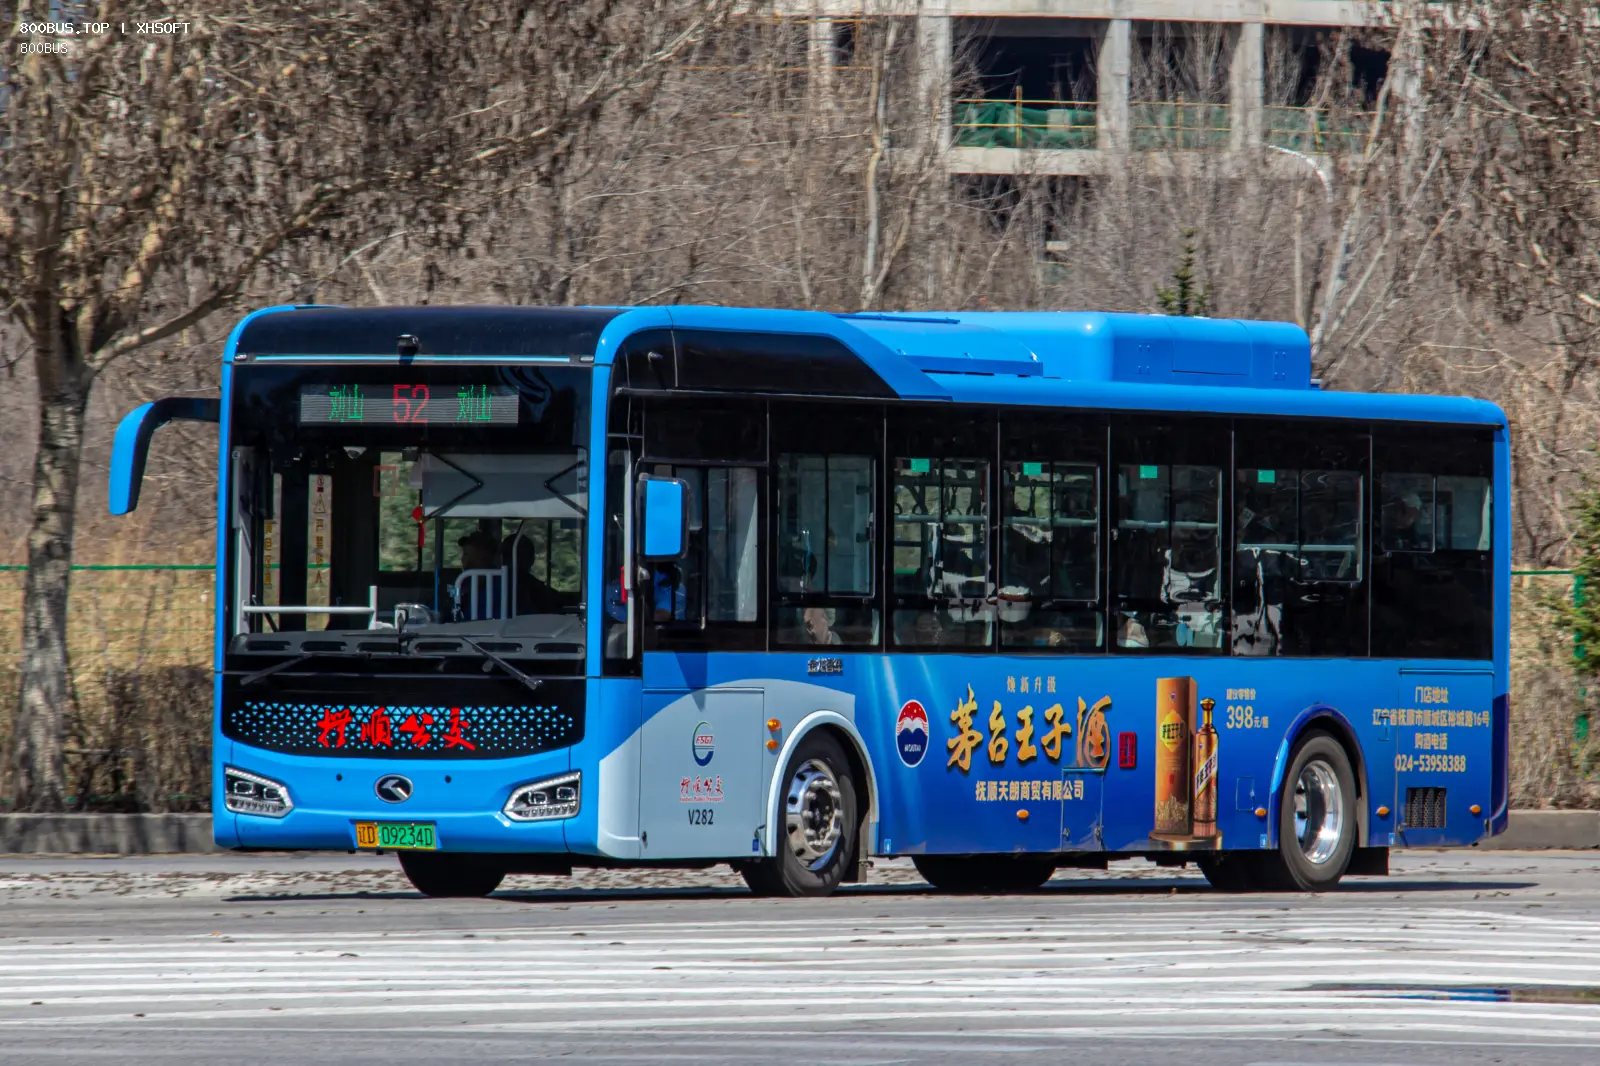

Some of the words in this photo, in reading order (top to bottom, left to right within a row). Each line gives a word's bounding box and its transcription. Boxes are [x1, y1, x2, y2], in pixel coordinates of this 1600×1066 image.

[329, 384, 364, 422] 刘山
[393, 384, 430, 423] 52
[456, 384, 492, 422] 刘山
[1415, 686, 1449, 703] 门店地址
[317, 707, 476, 750] 抚顺公交
[947, 683, 1112, 772] 茅台王子酒
[1394, 754, 1466, 772] 024-53958388
[975, 779, 1084, 801] 抚顺天朗商贸有限公司
[688, 809, 714, 825] V282
